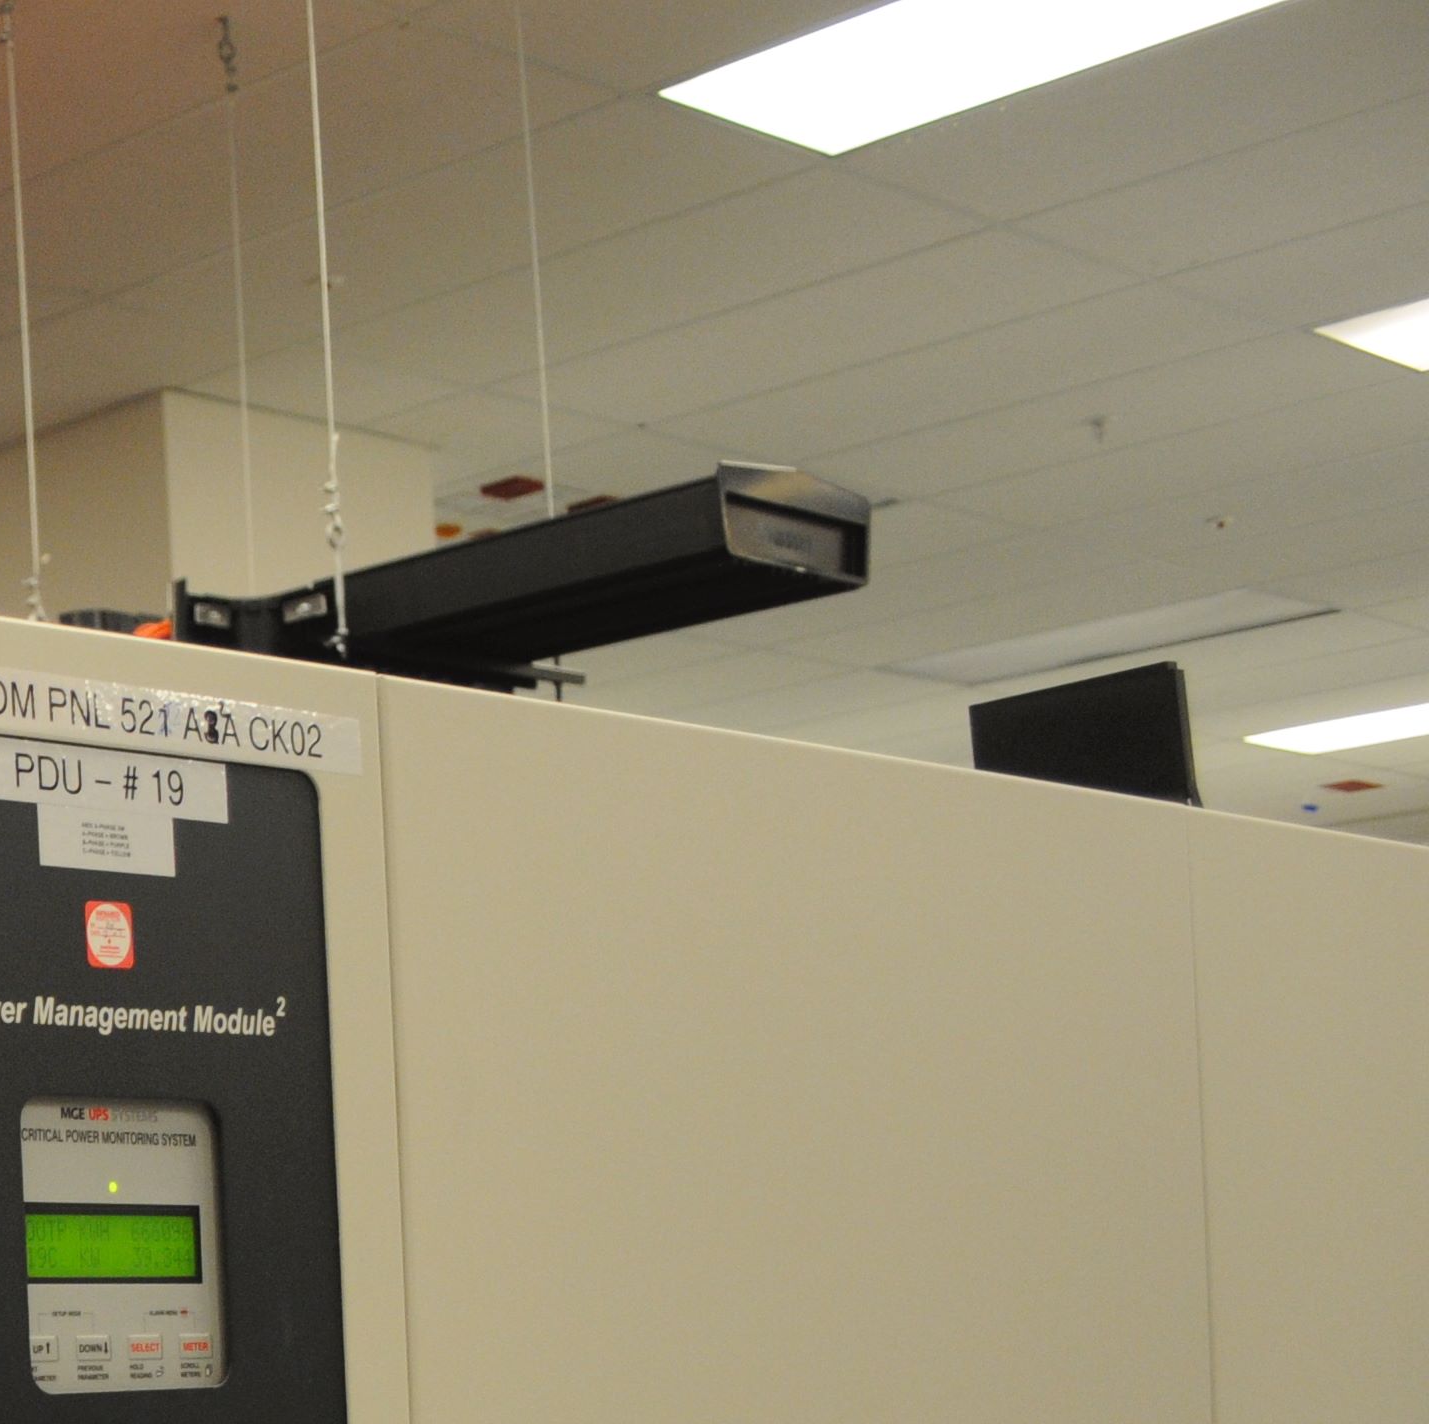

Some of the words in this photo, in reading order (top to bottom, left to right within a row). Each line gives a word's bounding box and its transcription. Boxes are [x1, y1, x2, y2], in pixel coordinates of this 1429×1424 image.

[47, 686, 111, 731] PNL
[248, 716, 324, 759] CK02
[14, 752, 83, 796] PDU
[122, 765, 140, 801] #
[151, 768, 185, 807] 19
[33, 995, 187, 1036] Management
[60, 1106, 86, 1121] MGE
[88, 1107, 111, 1122] UPS
[112, 1108, 159, 1123] SYSTEMS
[21, 1127, 64, 1143] CRITICAL
[65, 1130, 100, 1145] POWER
[101, 1131, 160, 1147] MONITORING
[161, 1134, 198, 1148] SYSTEM
[33, 1345, 44, 1354] UP
[79, 1344, 103, 1354] DOWN
[130, 1342, 160, 1354] SELECT
[182, 1341, 210, 1353] METER
